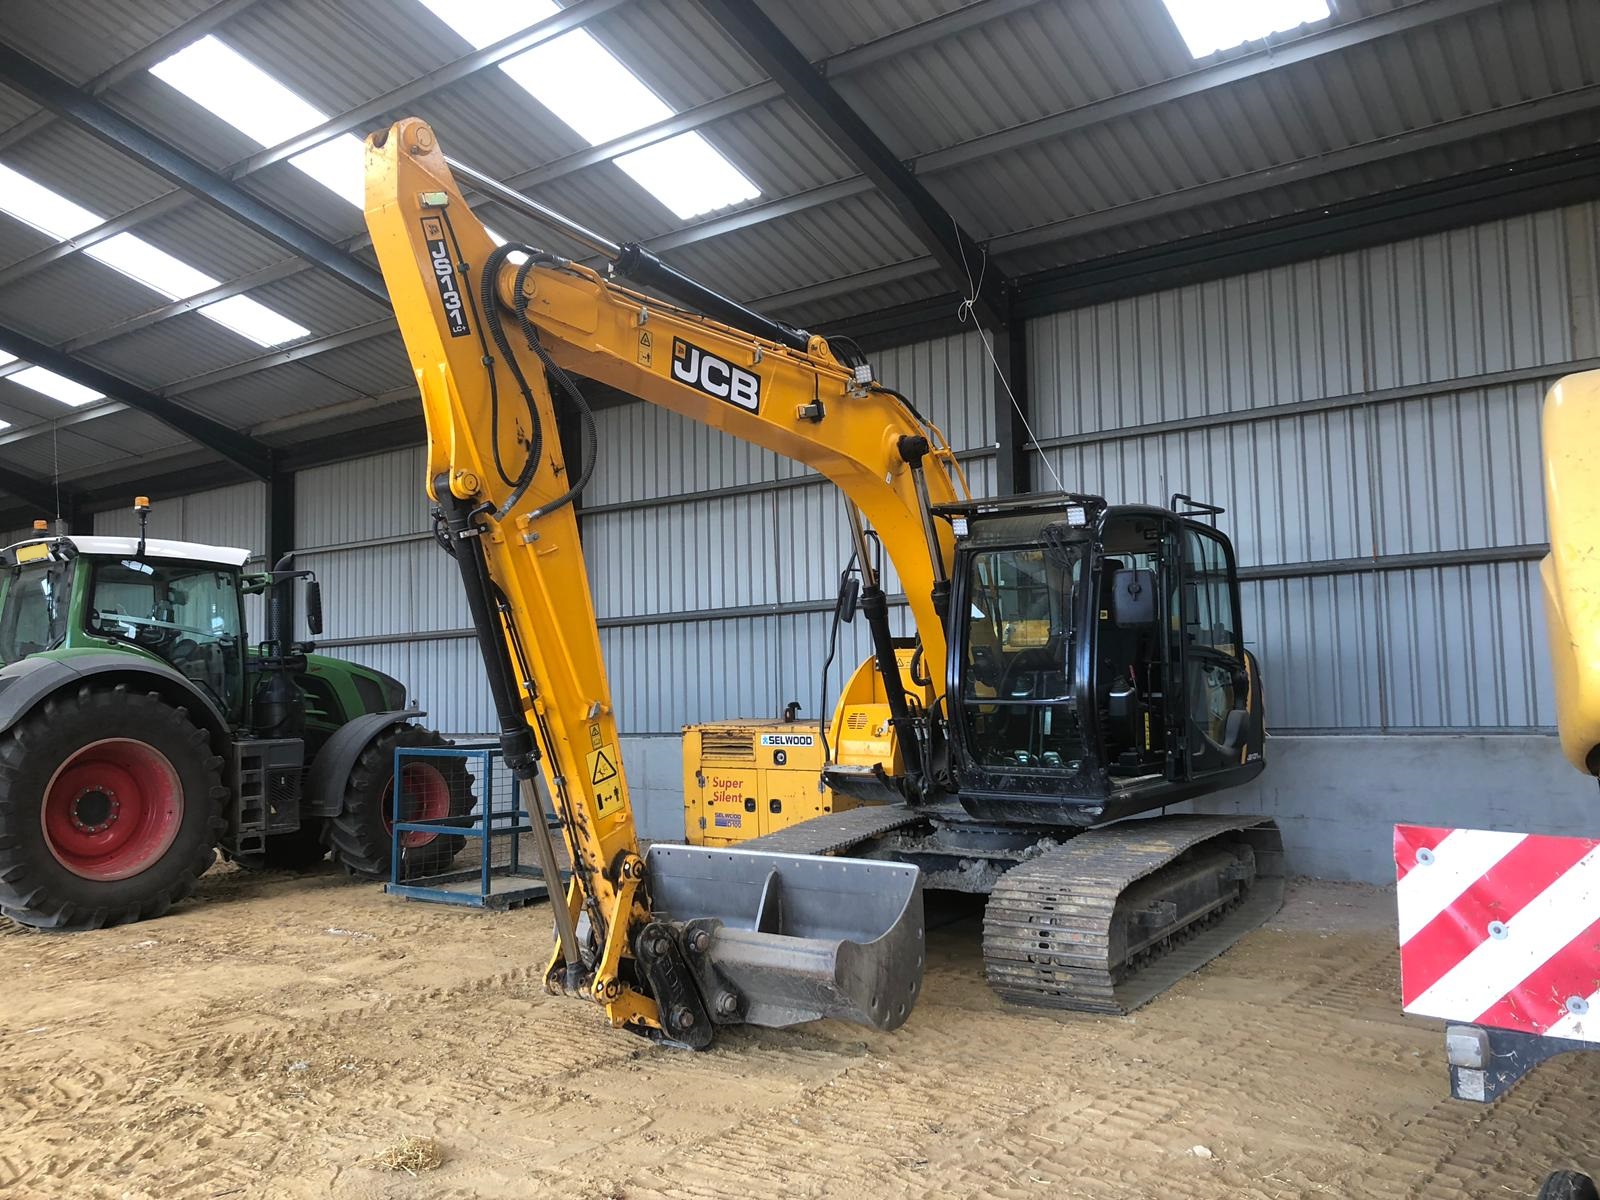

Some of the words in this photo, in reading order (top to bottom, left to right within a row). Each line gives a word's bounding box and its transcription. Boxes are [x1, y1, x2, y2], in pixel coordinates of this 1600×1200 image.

[432, 242, 462, 325] JS131
[674, 348, 758, 410] JCB
[768, 735, 813, 745] SELWOOD
[712, 776, 744, 791] Super
[713, 791, 743, 803] Silent
